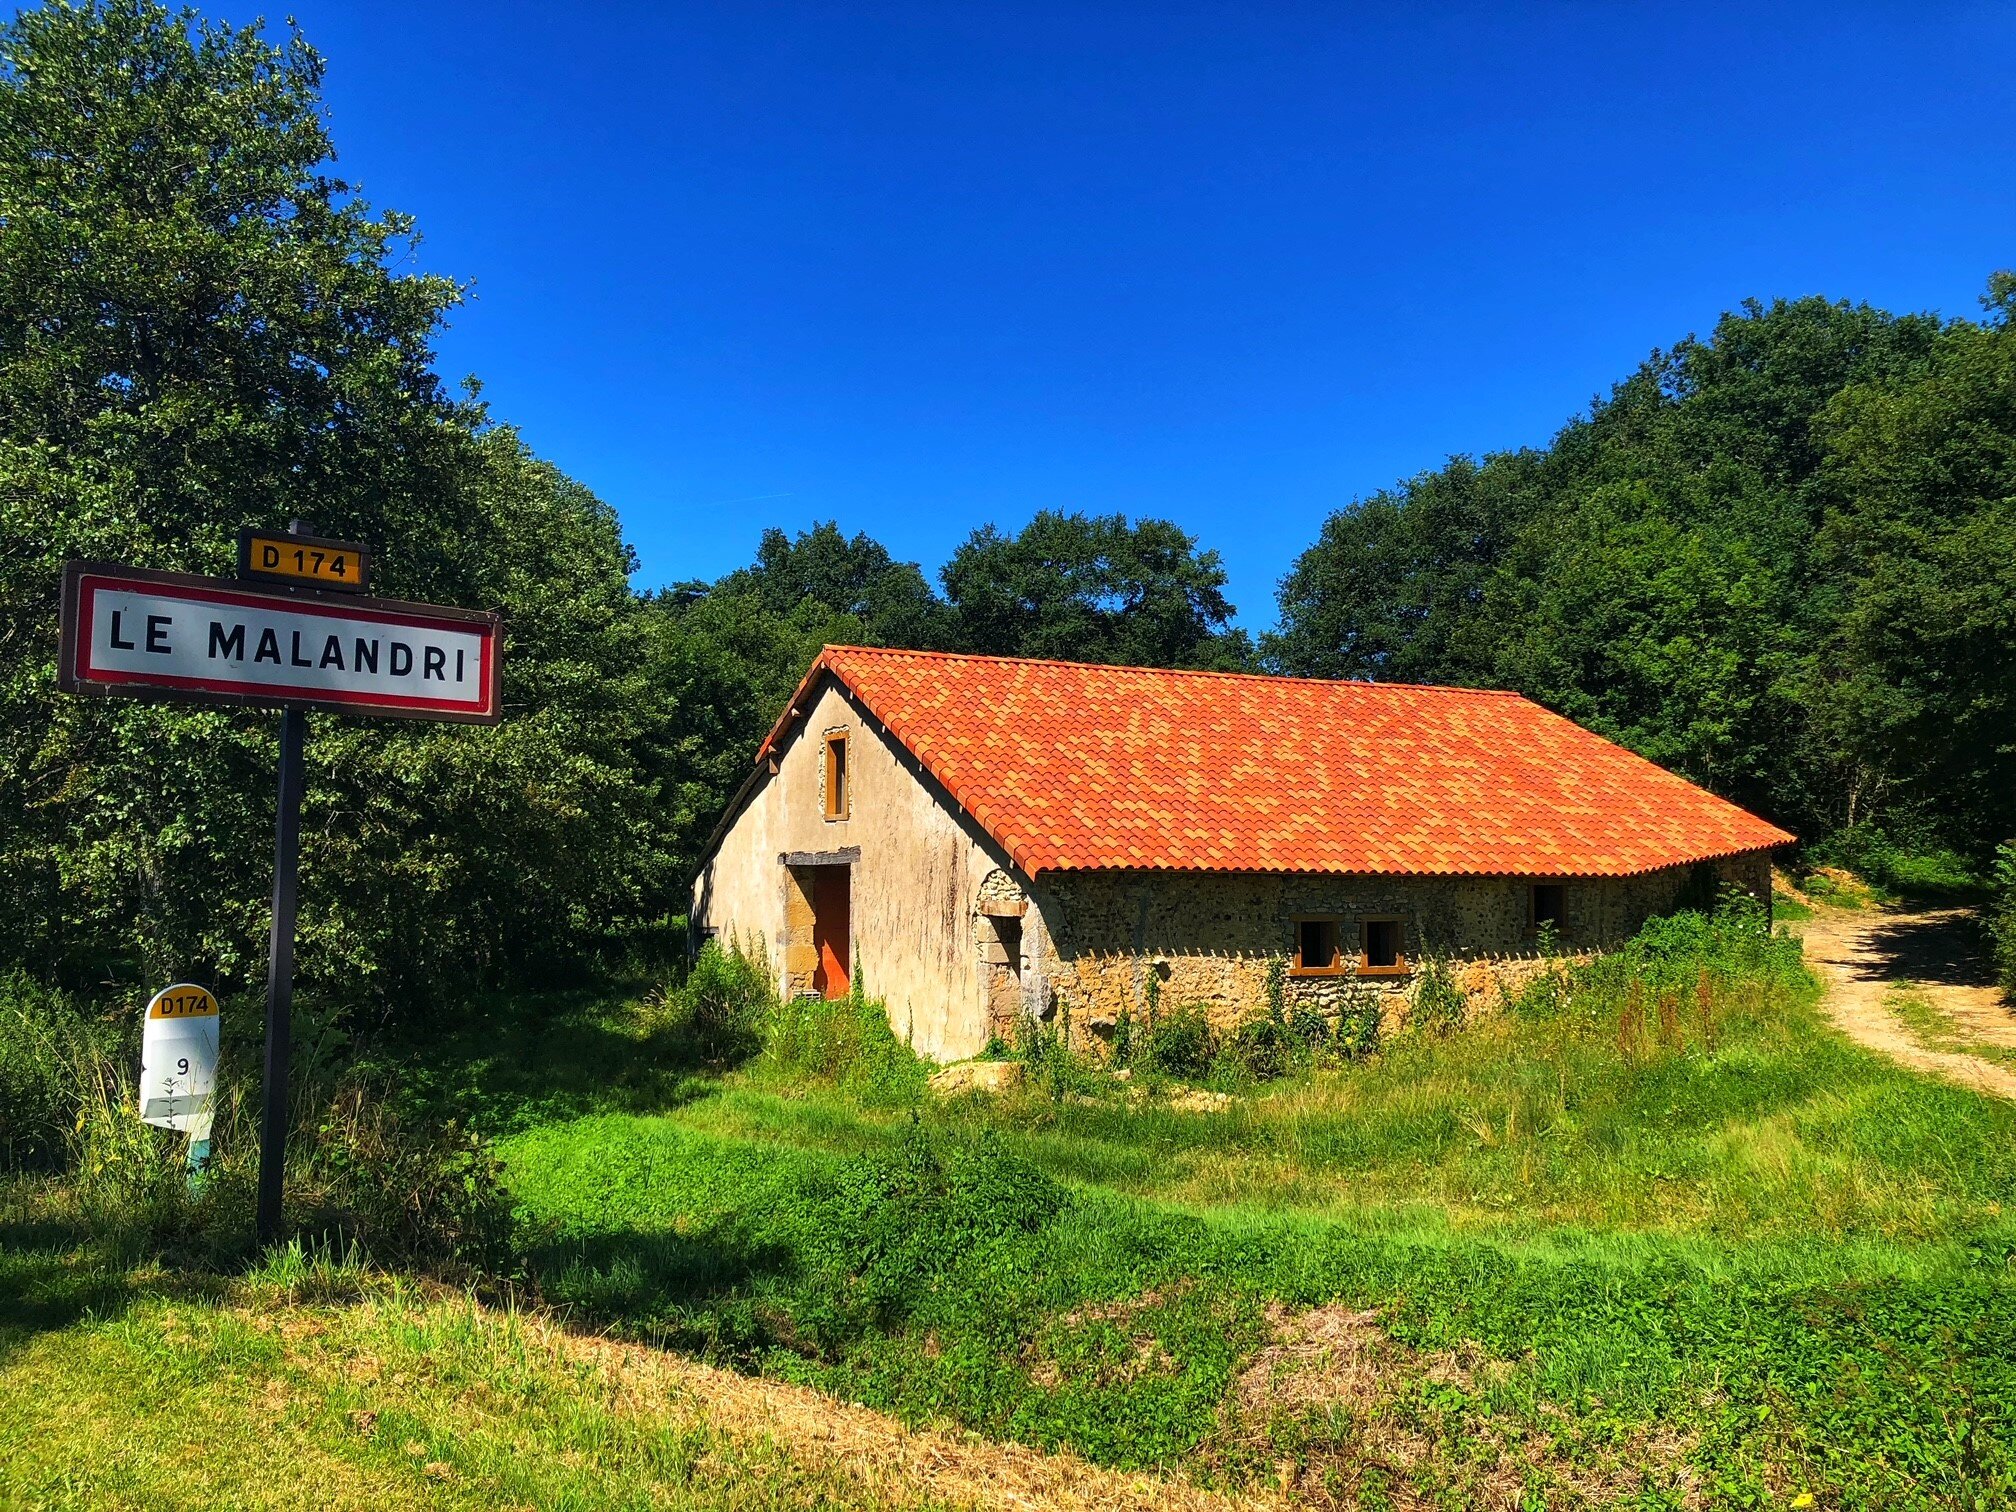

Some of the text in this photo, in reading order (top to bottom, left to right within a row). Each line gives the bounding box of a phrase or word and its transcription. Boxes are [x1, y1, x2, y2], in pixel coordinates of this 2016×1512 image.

[262, 545, 347, 578] D 174
[110, 610, 464, 683] LE MALANDRI
[161, 995, 208, 1015] D174
[177, 1058, 189, 1076] 9
